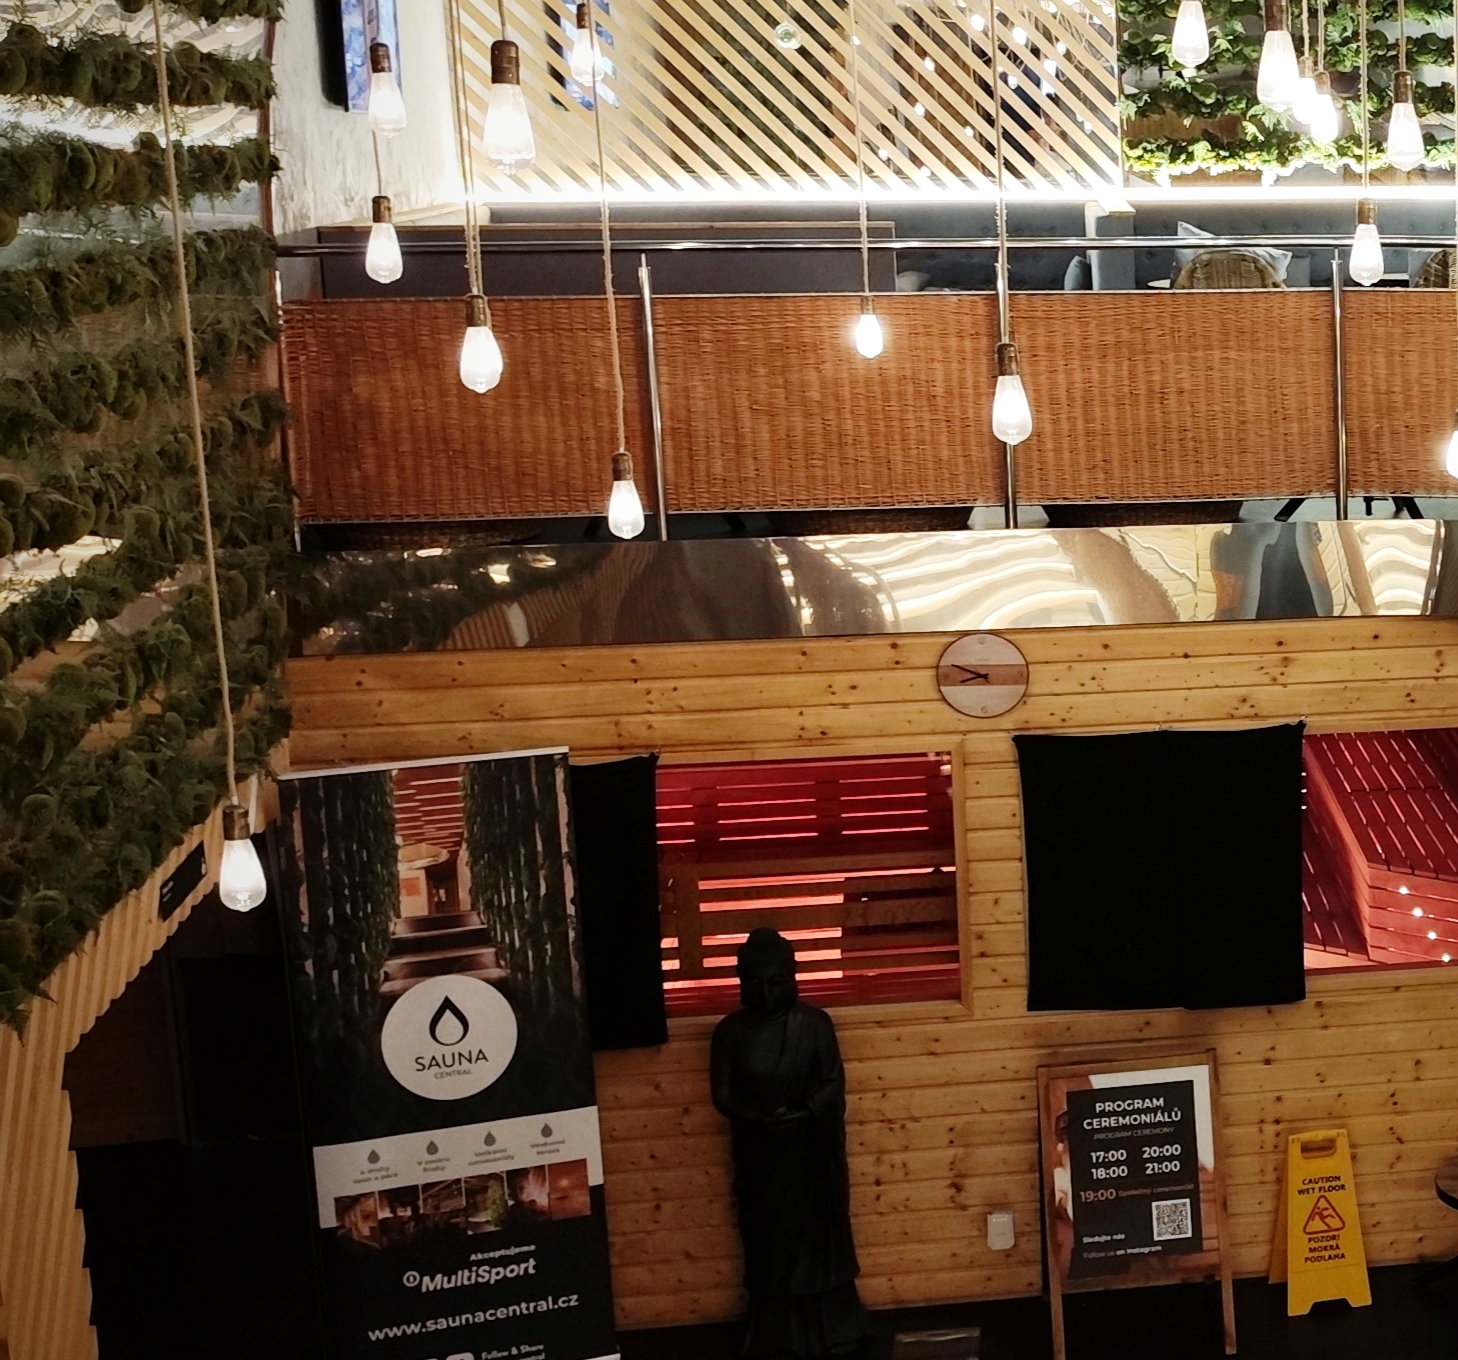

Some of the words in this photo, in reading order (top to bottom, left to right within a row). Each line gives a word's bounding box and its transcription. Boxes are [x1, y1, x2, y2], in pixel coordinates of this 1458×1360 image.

[414, 1048, 489, 1072] SAUNA
[434, 1069, 472, 1080] CENTRAL
[1095, 1097, 1165, 1113] PROGRAM
[1083, 1107, 1181, 1130] CEREMONIÁLŮ
[1094, 1131, 1132, 1140] PROGRAM
[1090, 1149, 1127, 1164] 17:00
[1142, 1144, 1181, 1159] 20:00
[1091, 1165, 1129, 1180] 18:00
[1145, 1161, 1181, 1175] 21:00
[1302, 1176, 1341, 1185] CAUTION
[1080, 1188, 1116, 1202] 19:00
[1297, 1187, 1316, 1195] WET
[1318, 1184, 1346, 1193] FLOOR
[469, 1244, 536, 1262] Akceptujeme
[1304, 1252, 1346, 1264] PODLAHA
[421, 1258, 537, 1293] MultiSport
[368, 1294, 580, 1342] www.saunacentral.cz
[482, 1350, 509, 1360] Follow
